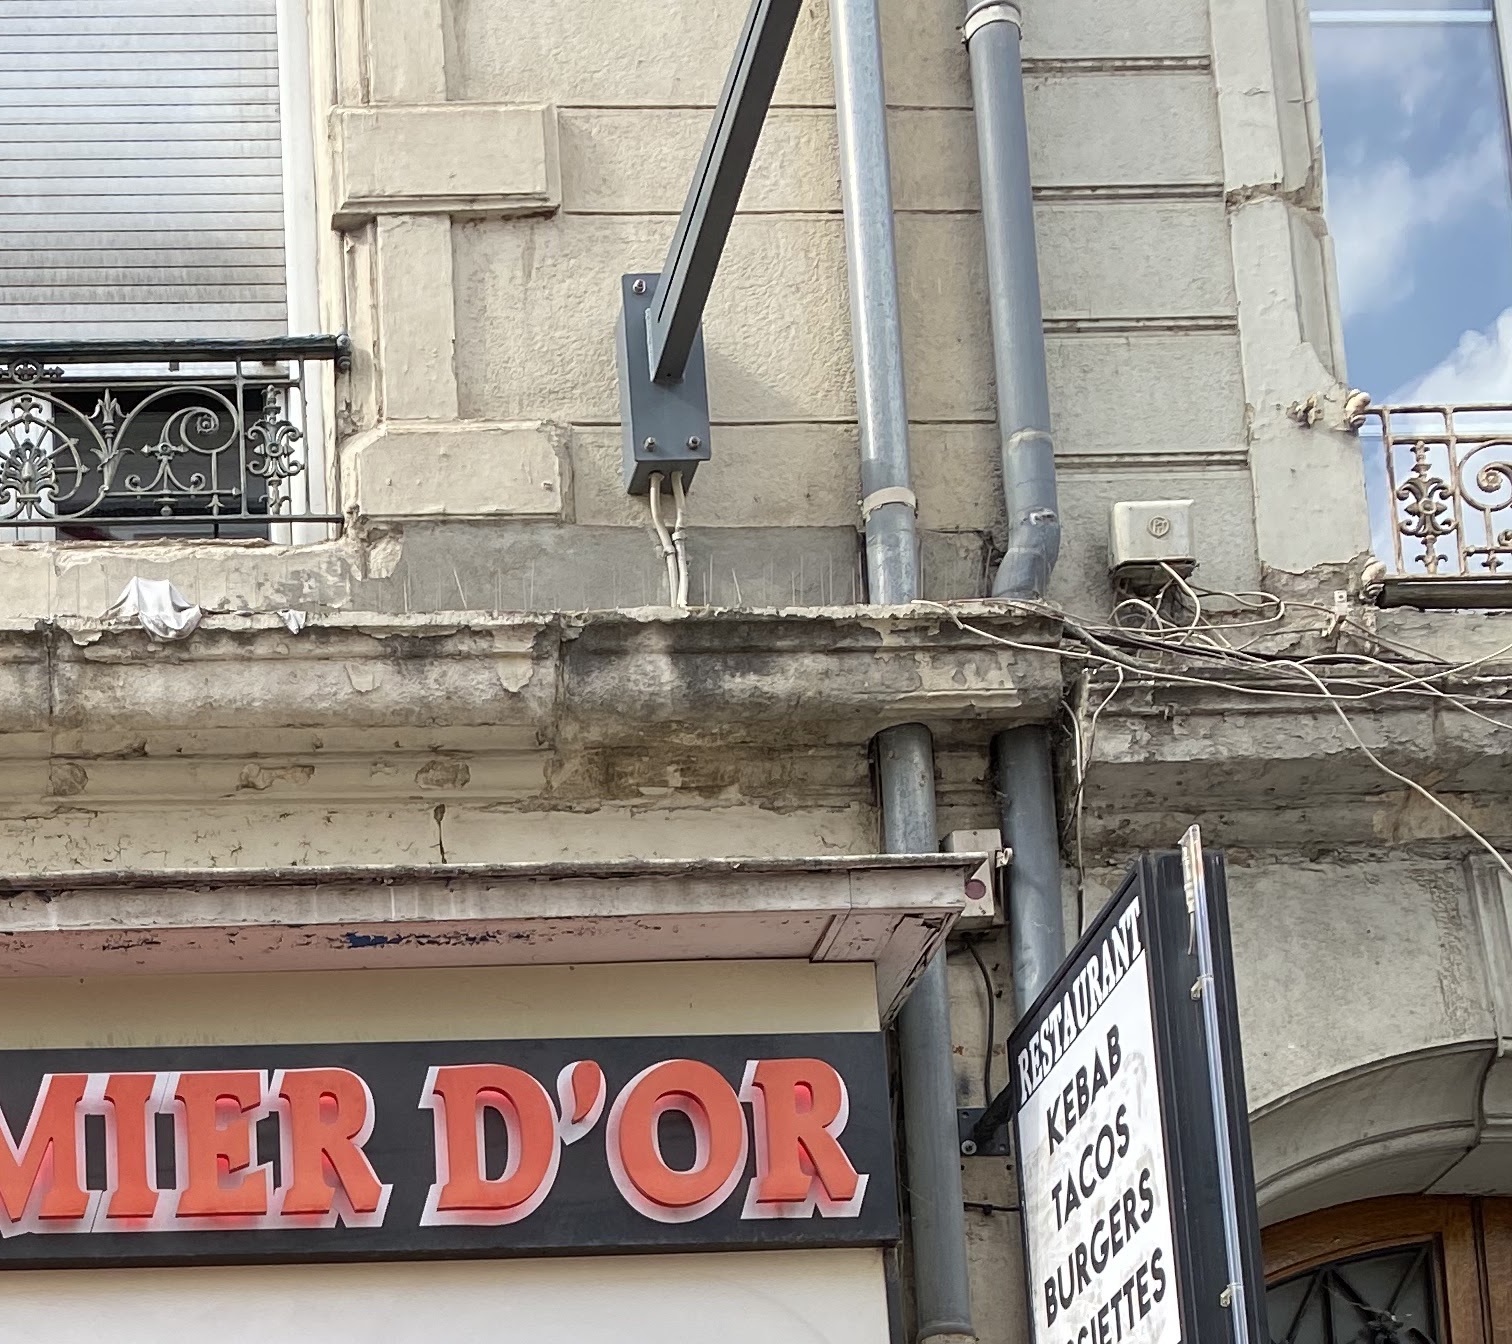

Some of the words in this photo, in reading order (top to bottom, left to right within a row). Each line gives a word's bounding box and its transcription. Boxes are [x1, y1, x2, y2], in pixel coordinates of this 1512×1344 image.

[1016, 896, 1146, 1102] RESTAURANT
[418, 1057, 869, 1228] D'OR
[1044, 1025, 1124, 1157] KEBAB
[1051, 1103, 1131, 1232] TACOS
[1042, 1167, 1155, 1330] BURGERS
